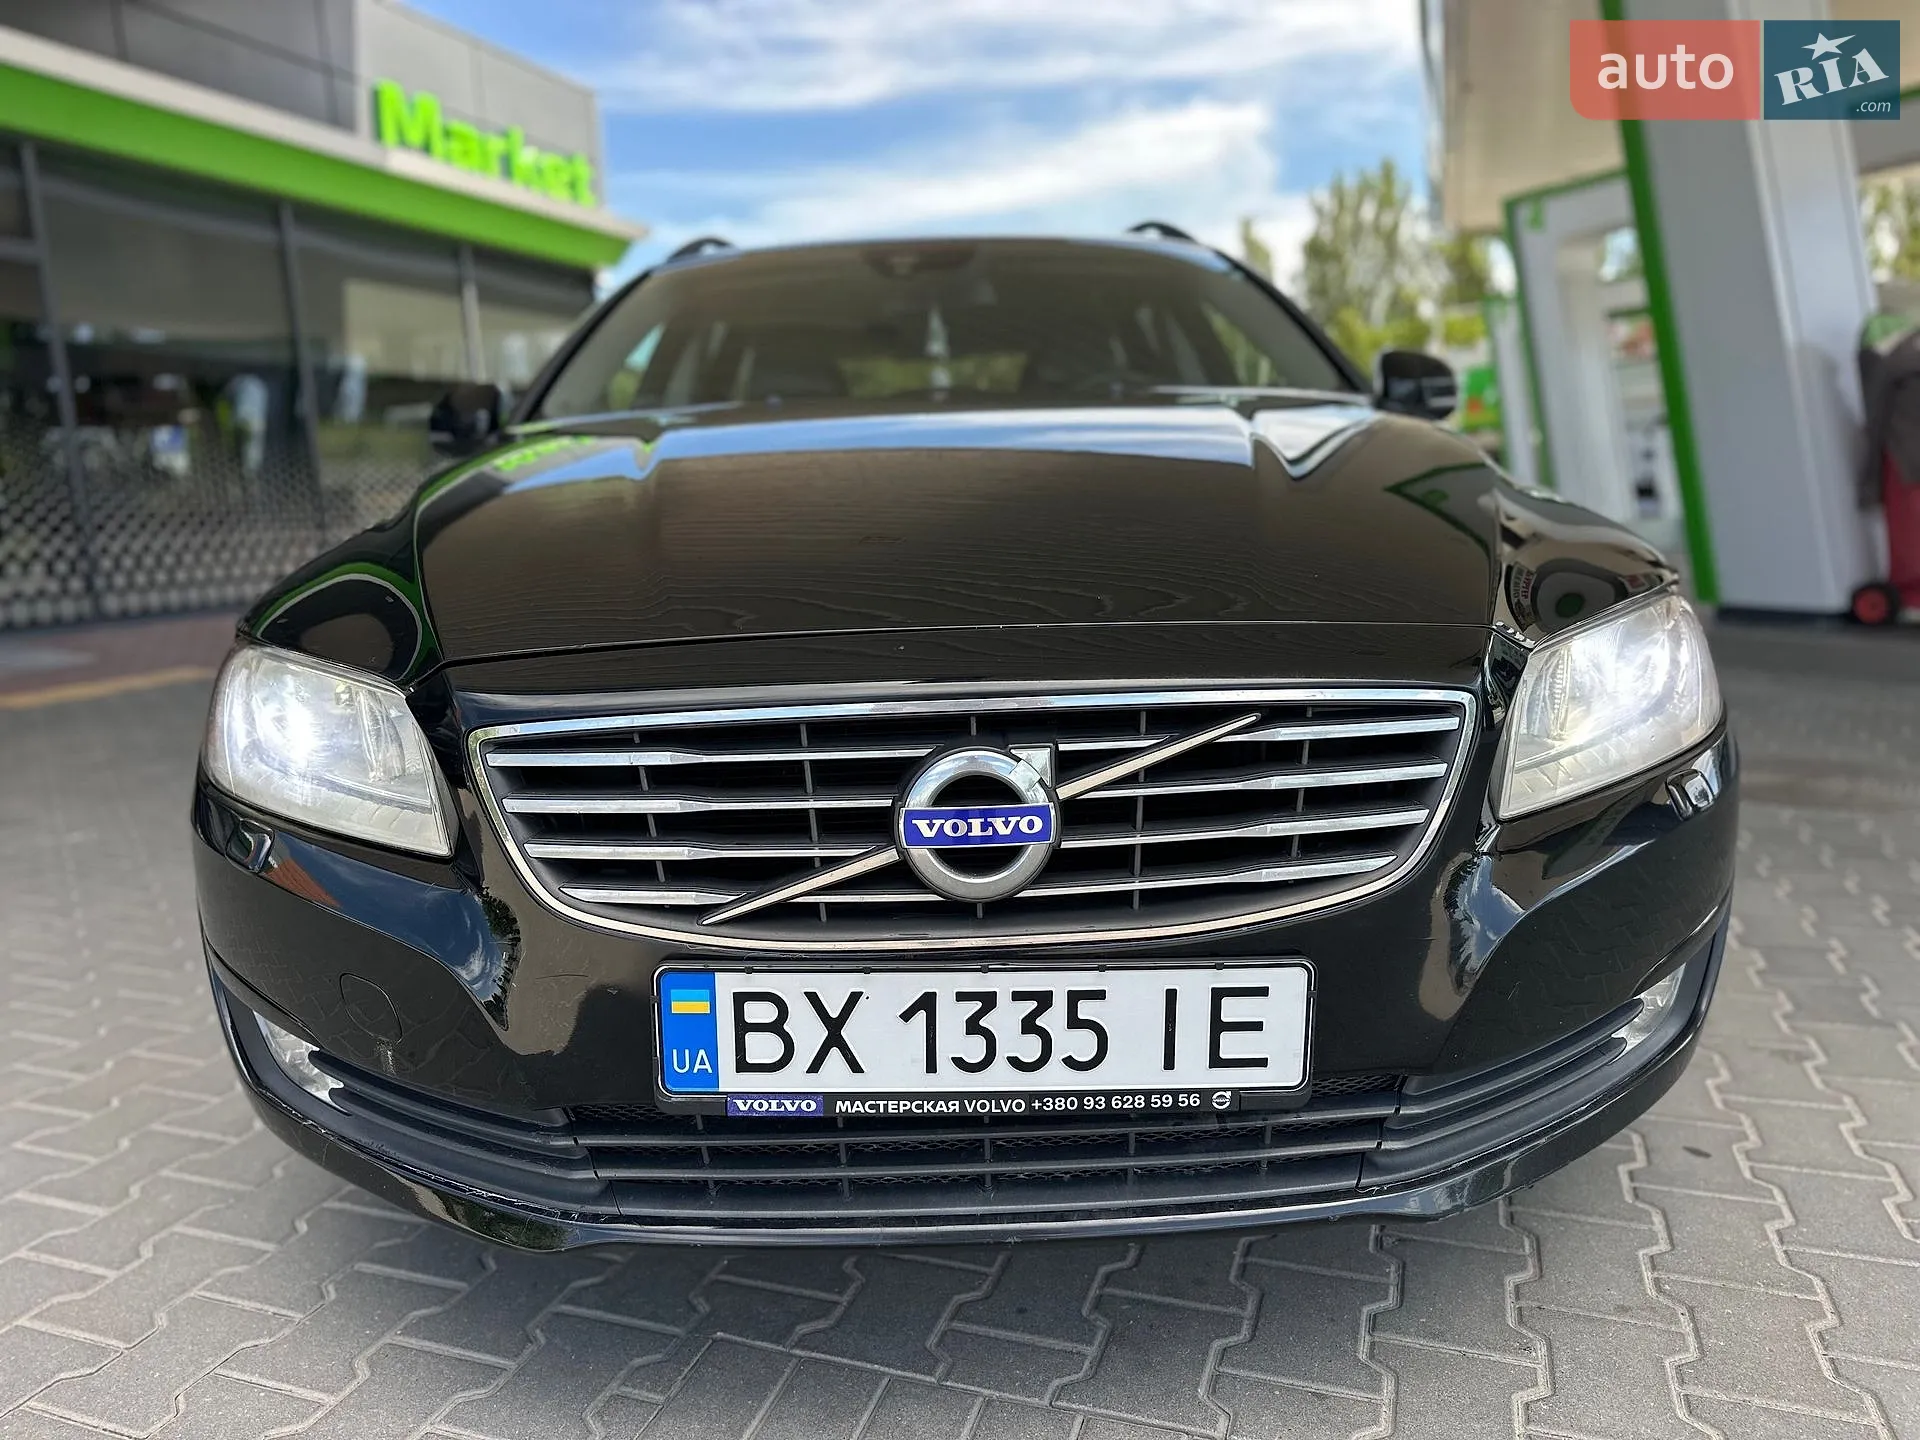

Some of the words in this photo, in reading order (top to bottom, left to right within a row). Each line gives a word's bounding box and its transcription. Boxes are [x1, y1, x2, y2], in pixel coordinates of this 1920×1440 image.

[373, 77, 597, 207] Market
[911, 815, 1044, 838] VOLVO
[898, 988, 1109, 1074] 1335
[672, 1049, 713, 1074] UA
[732, 1099, 818, 1113] VOLVO
[835, 1099, 960, 1115] МАСТЕРСКАЯ
[964, 1098, 1026, 1114] VOLVO
[1031, 1097, 1078, 1112] +380
[1083, 1096, 1106, 1110] 93
[1111, 1095, 1145, 1110] 628
[1150, 1094, 1173, 1109] 59
[1178, 1093, 1201, 1108] 56
